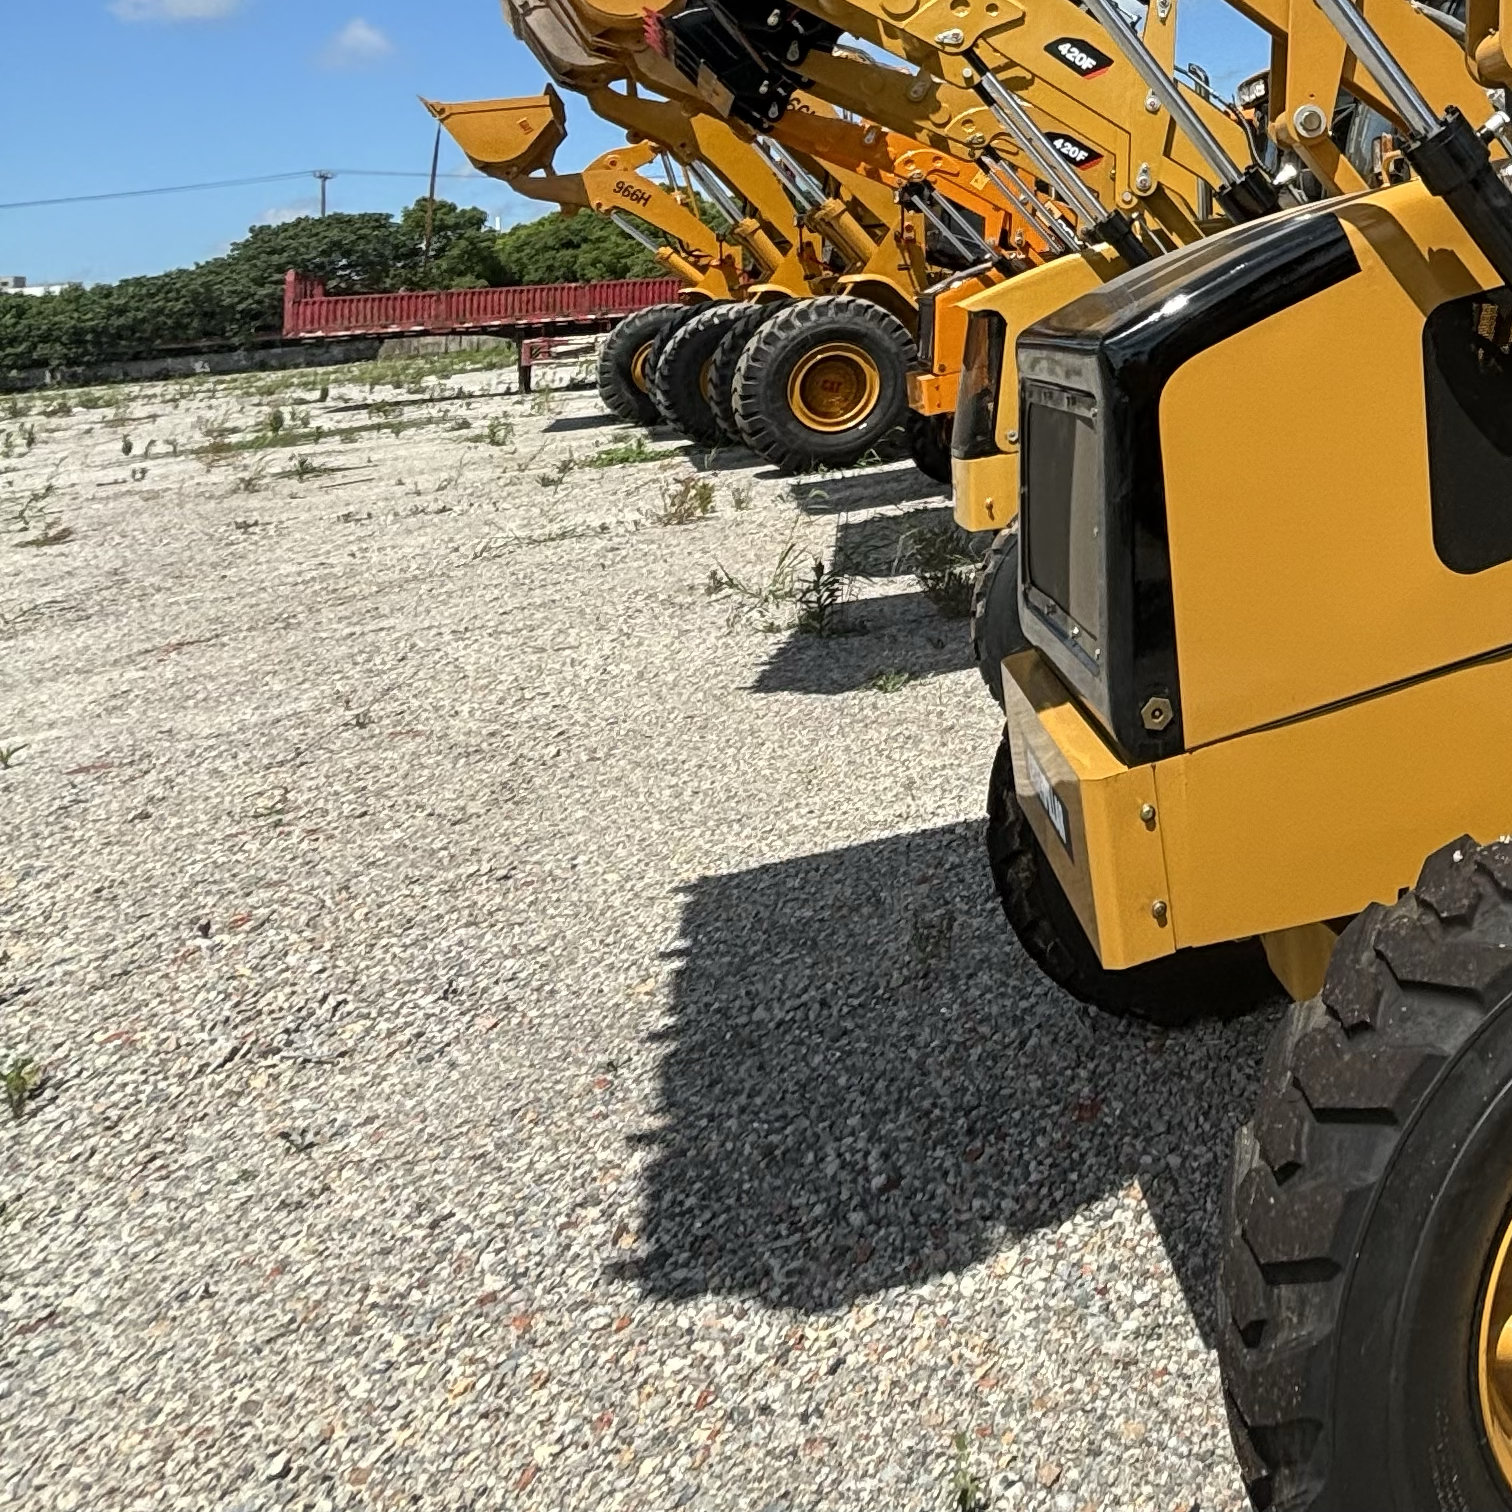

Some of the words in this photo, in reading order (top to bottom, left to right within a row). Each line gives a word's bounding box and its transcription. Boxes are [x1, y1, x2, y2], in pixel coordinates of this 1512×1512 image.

[1057, 42, 1098, 71] 420F
[1052, 137, 1089, 162] 420F
[612, 180, 653, 208] 966H
